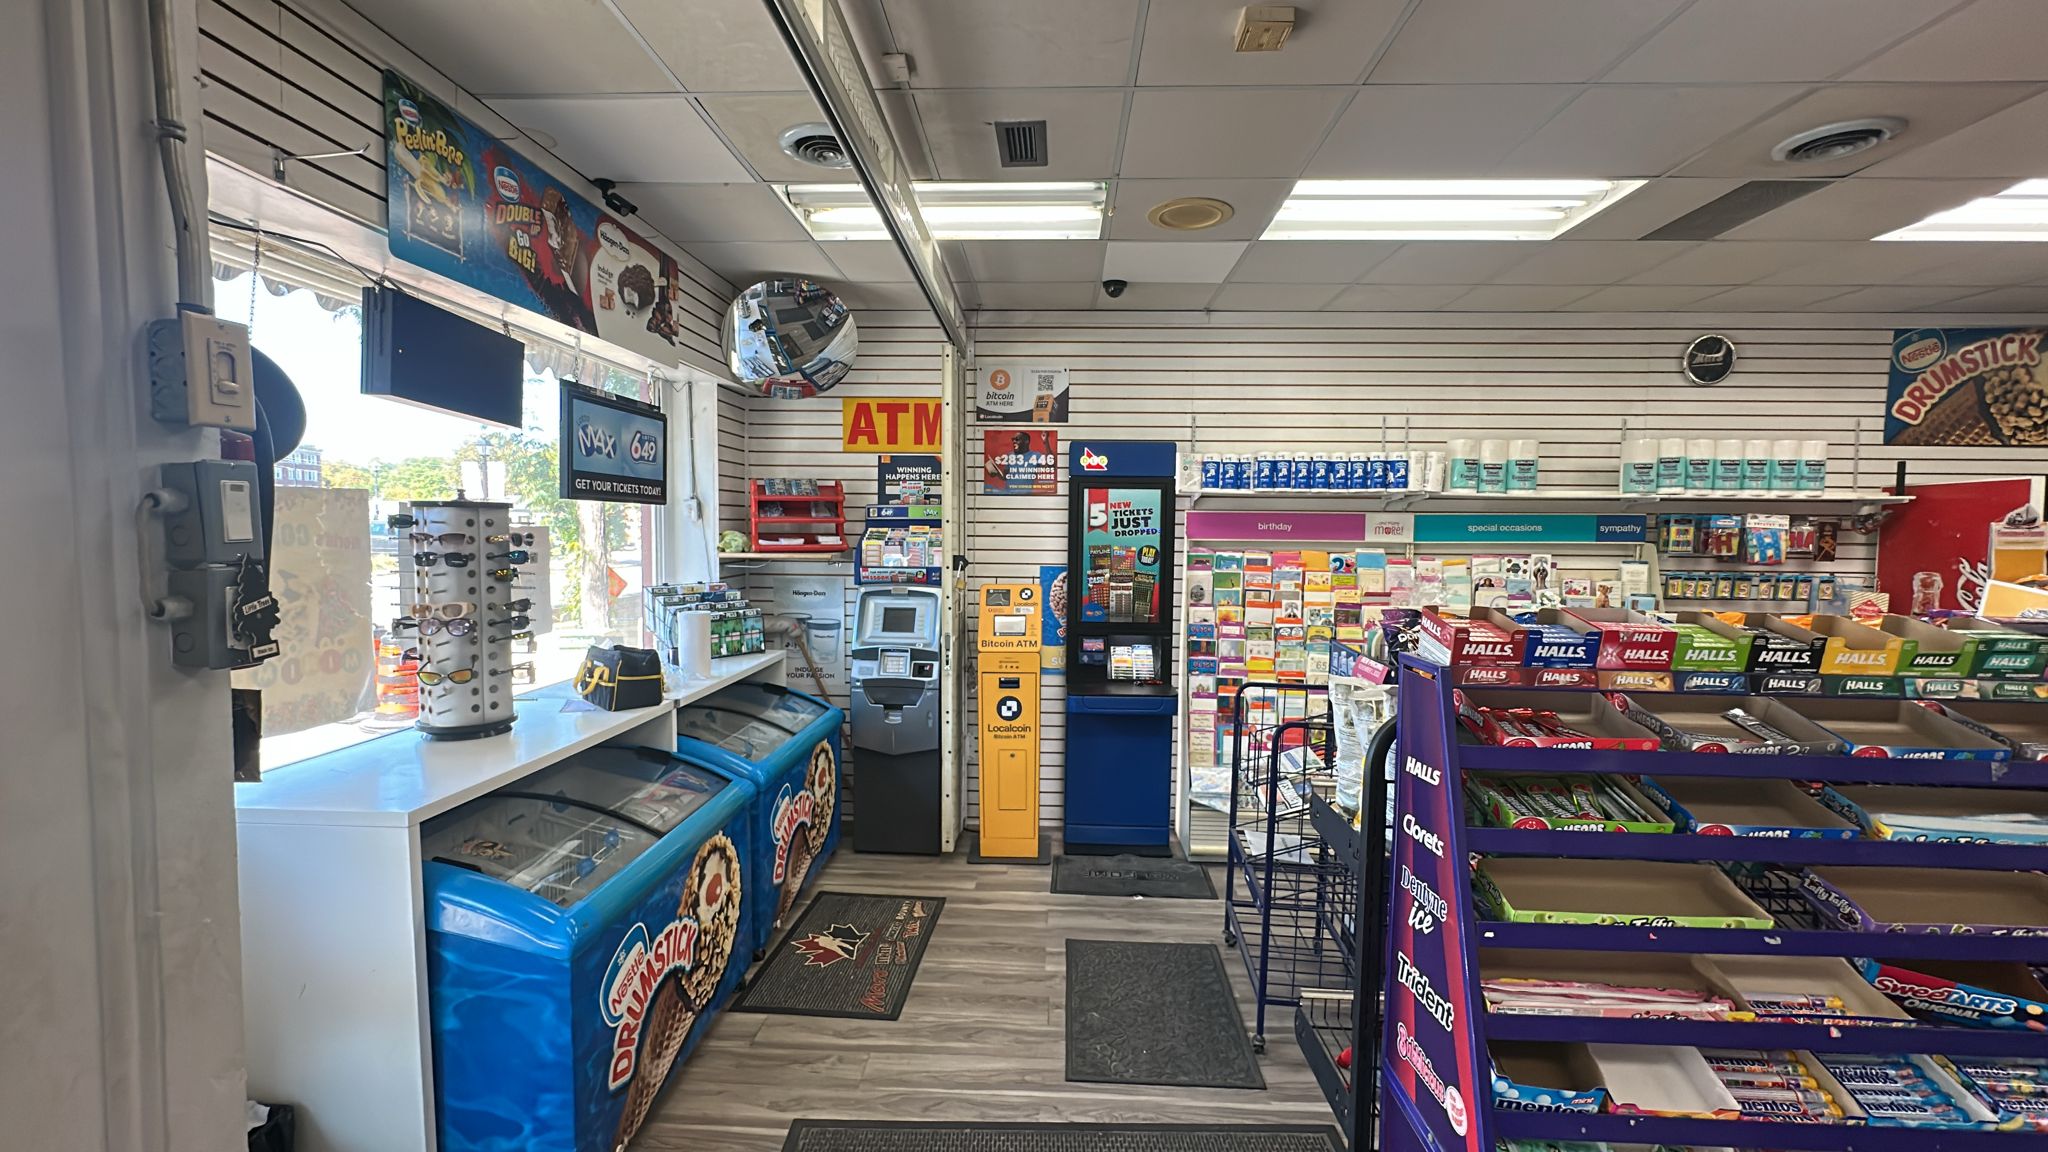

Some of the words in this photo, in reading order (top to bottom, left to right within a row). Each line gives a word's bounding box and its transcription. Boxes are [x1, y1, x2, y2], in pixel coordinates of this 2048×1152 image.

[435, 130, 464, 166] Pops
[496, 204, 541, 224] DOUBLE
[530, 225, 541, 236] UP
[516, 229, 530, 247] GO
[508, 237, 536, 273] BIG!
[1901, 342, 1940, 365] Nestlé
[1894, 335, 2038, 423] DRUMSTICK
[985, 391, 1015, 400] bitcoin
[847, 403, 942, 446] ATM
[578, 424, 615, 459] MAX
[995, 454, 1055, 468] $283,446
[896, 466, 932, 474] WINNING
[885, 473, 920, 481] HAPPENS
[575, 478, 591, 490] GET
[592, 480, 612, 491] YOUR
[613, 482, 639, 494] TICKETS
[1109, 501, 1132, 510] NEW
[1089, 502, 1108, 528] 5
[1112, 508, 1154, 517] TICKETS
[1111, 516, 1152, 530] JUST
[1258, 522, 1293, 532] birthday
[1467, 523, 1498, 533] special
[1499, 524, 1543, 532] occasions
[1600, 524, 1642, 534] sympathy
[1141, 546, 1157, 557] PLAY
[256, 599, 270, 609] Trees
[1421, 615, 1442, 638] HALLS
[981, 639, 1014, 648] Bitcoin
[1016, 639, 1038, 648] ATM
[1462, 643, 1514, 657] HALLS
[1534, 645, 1587, 659] HALLS
[1624, 649, 1669, 661] HALLS
[1684, 650, 1738, 662] HALLS
[1757, 650, 1812, 664] HALLS
[1834, 653, 1888, 666] HALLS
[1913, 656, 1955, 665] HALLS
[1988, 657, 2031, 667] HALLS
[1469, 670, 1507, 679] HALLS
[1542, 673, 1580, 682] HALLS
[1616, 676, 1654, 685] HALLS
[1691, 677, 1730, 686] HALLS
[1768, 678, 1806, 689] HALLS
[1845, 680, 1884, 690] HALLS
[1926, 682, 1960, 692] HALLS
[987, 723, 1032, 733] Localcoin
[1405, 755, 1442, 787] HALLS
[774, 794, 814, 880] DRUMSTICK
[1403, 813, 1444, 859] Clorets
[1400, 864, 1448, 923] Dentyne
[1828, 891, 1852, 914] Taffy
[1407, 900, 1434, 935] ice
[611, 946, 645, 1014] Nestlé
[1397, 950, 1455, 1032] Trident
[611, 923, 697, 1084] DRUMSTICK
[1903, 999, 1982, 1021] ORIGINAL
[1570, 1096, 1595, 1105] mint
